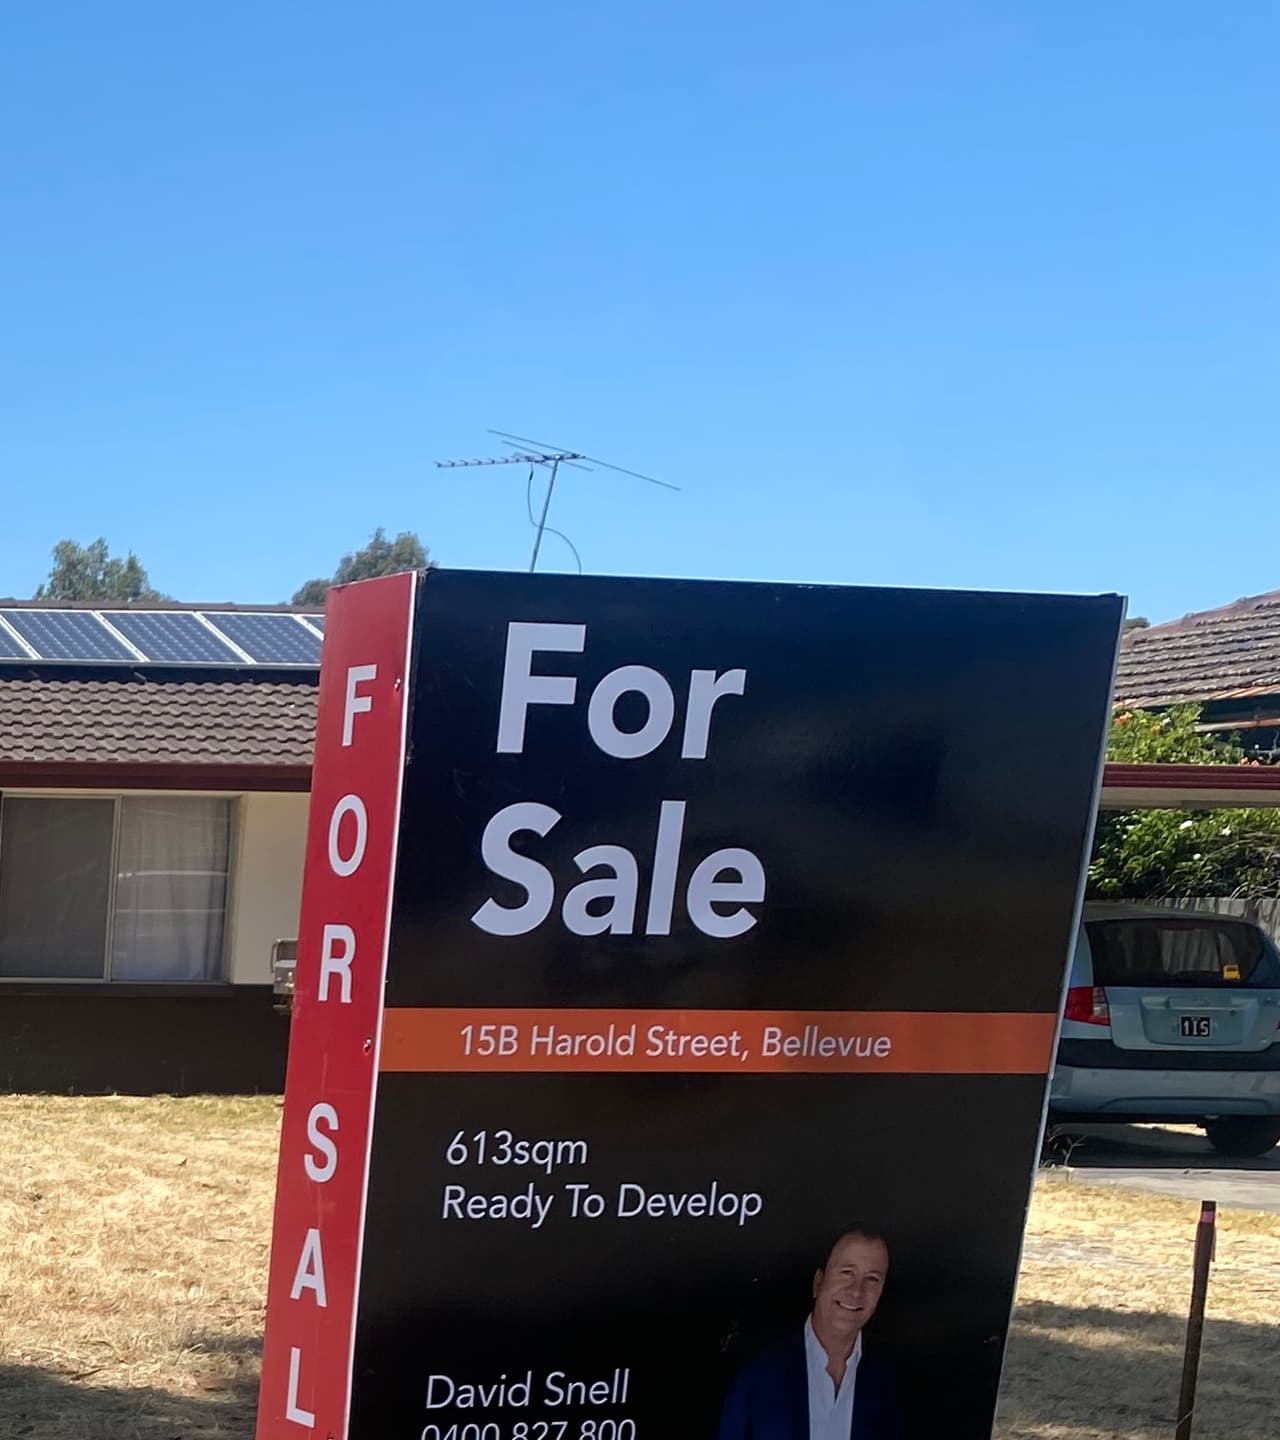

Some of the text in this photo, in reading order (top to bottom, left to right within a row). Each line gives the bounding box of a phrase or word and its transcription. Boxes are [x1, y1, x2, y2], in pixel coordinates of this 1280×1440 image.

[496, 622, 747, 760] For
[318, 664, 378, 1004] FOR
[470, 800, 767, 938] Sale
[459, 1023, 892, 1062] 15B Harold Street, Bellevue
[446, 1130, 588, 1175] 613sqm
[442, 1181, 763, 1229] Ready To Develop
[425, 1367, 630, 1410] David Snell
